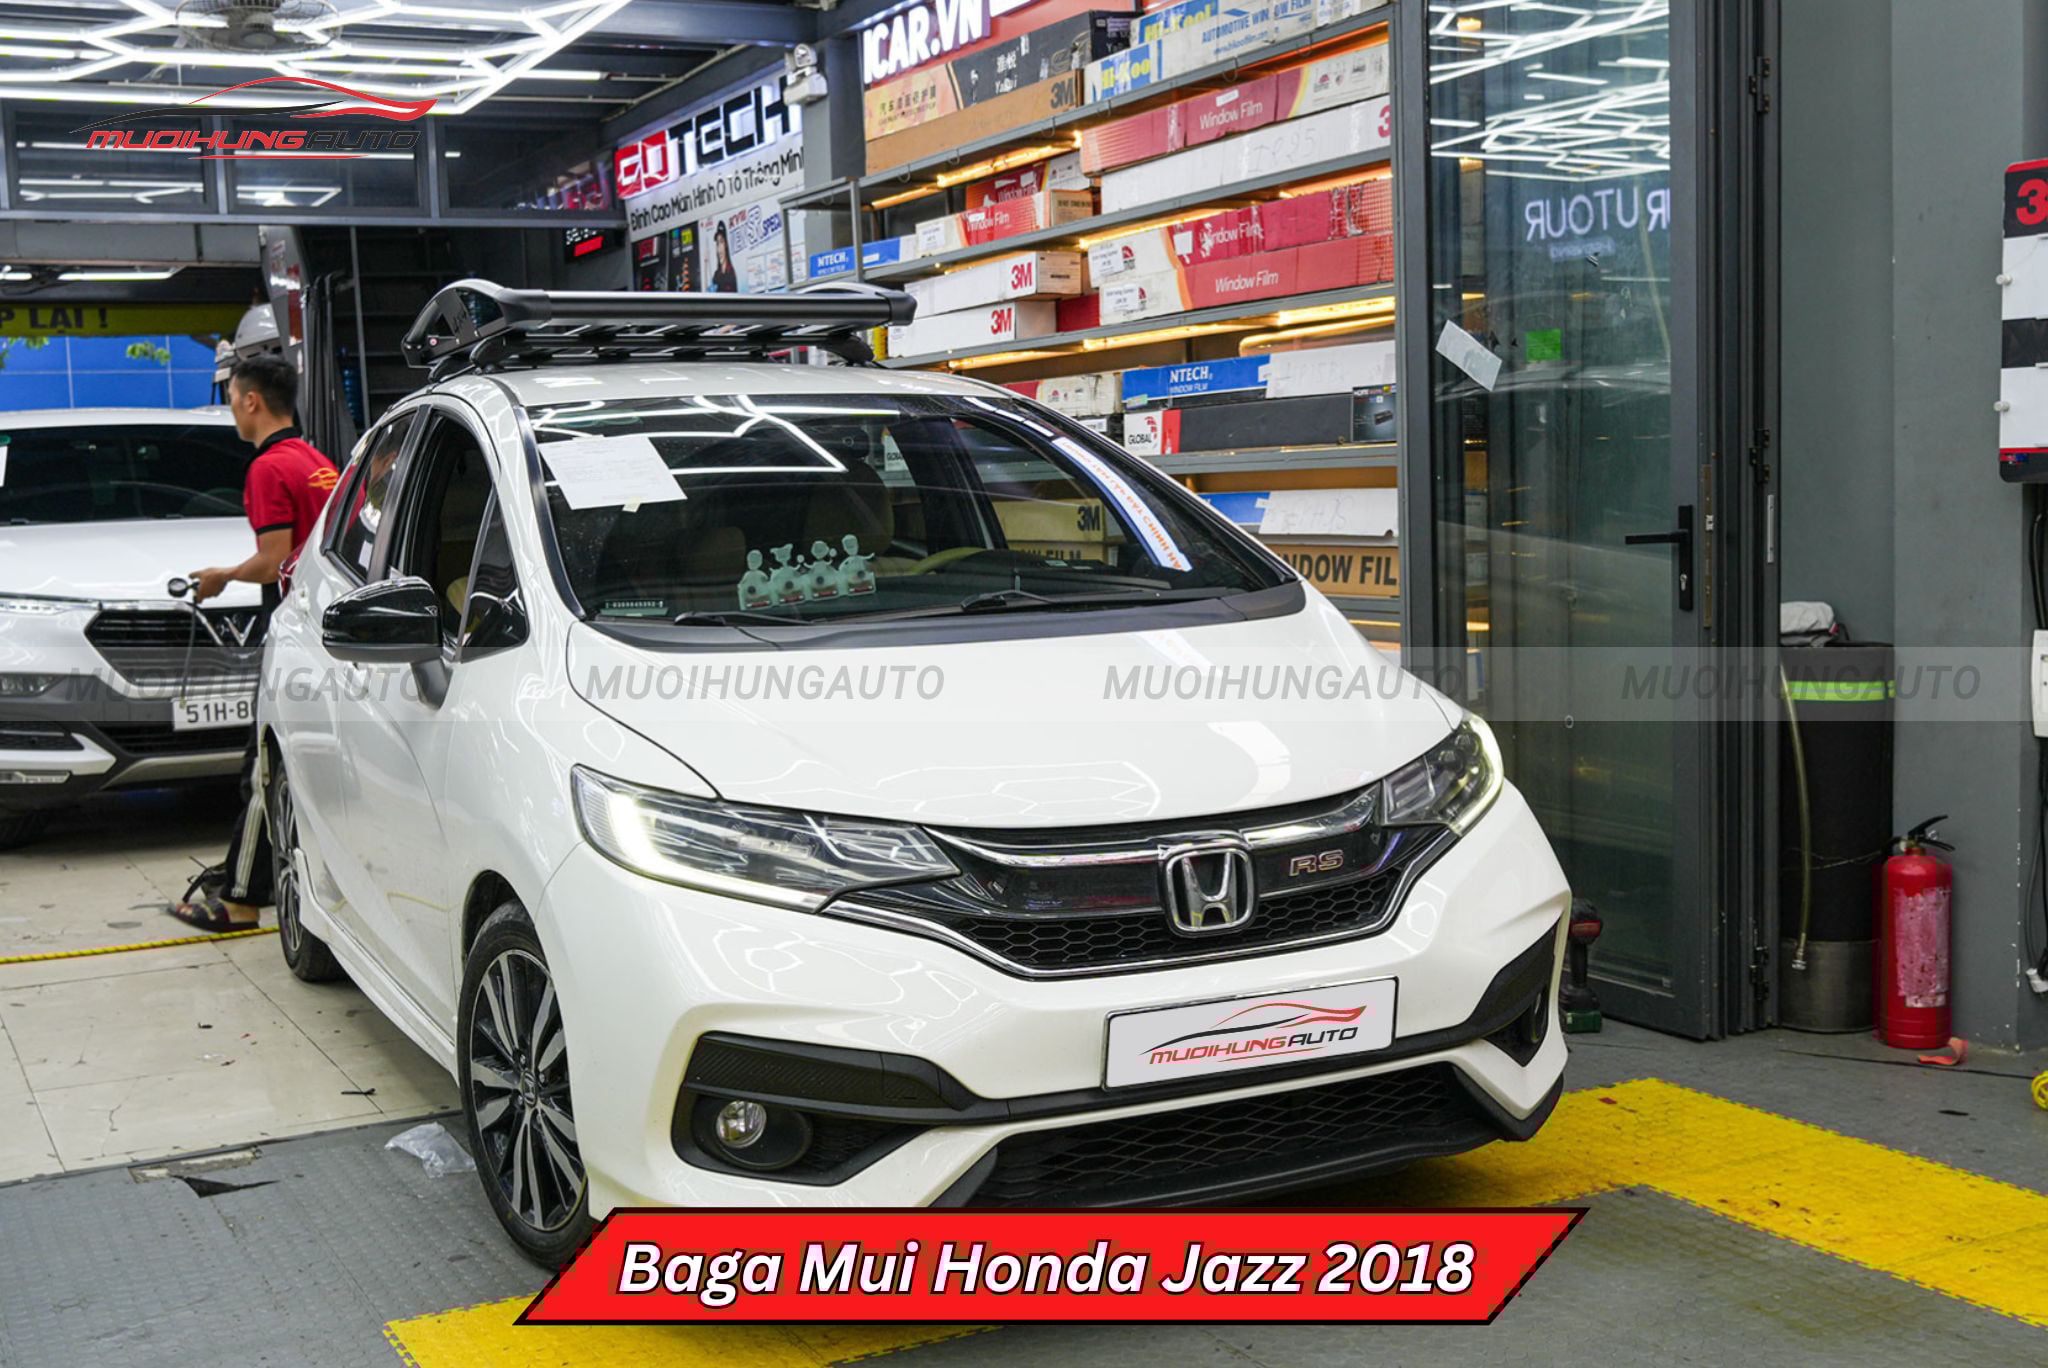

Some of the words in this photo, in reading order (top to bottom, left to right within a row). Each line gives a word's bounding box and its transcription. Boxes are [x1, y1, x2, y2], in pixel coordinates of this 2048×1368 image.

[1051, 78, 1075, 109] 3M
[1200, 109, 1239, 129] Window
[1241, 101, 1263, 118] Film
[651, 202, 671, 223] Cao
[2016, 177, 2048, 226] 3
[1011, 262, 1033, 290] 3M
[1215, 275, 1255, 293] Window
[1256, 270, 1279, 287] Film
[991, 308, 1013, 335] 3M
[1128, 434, 1152, 445] GLOBAL
[1077, 505, 1100, 531] 3M
[1289, 850, 1343, 876] RS
